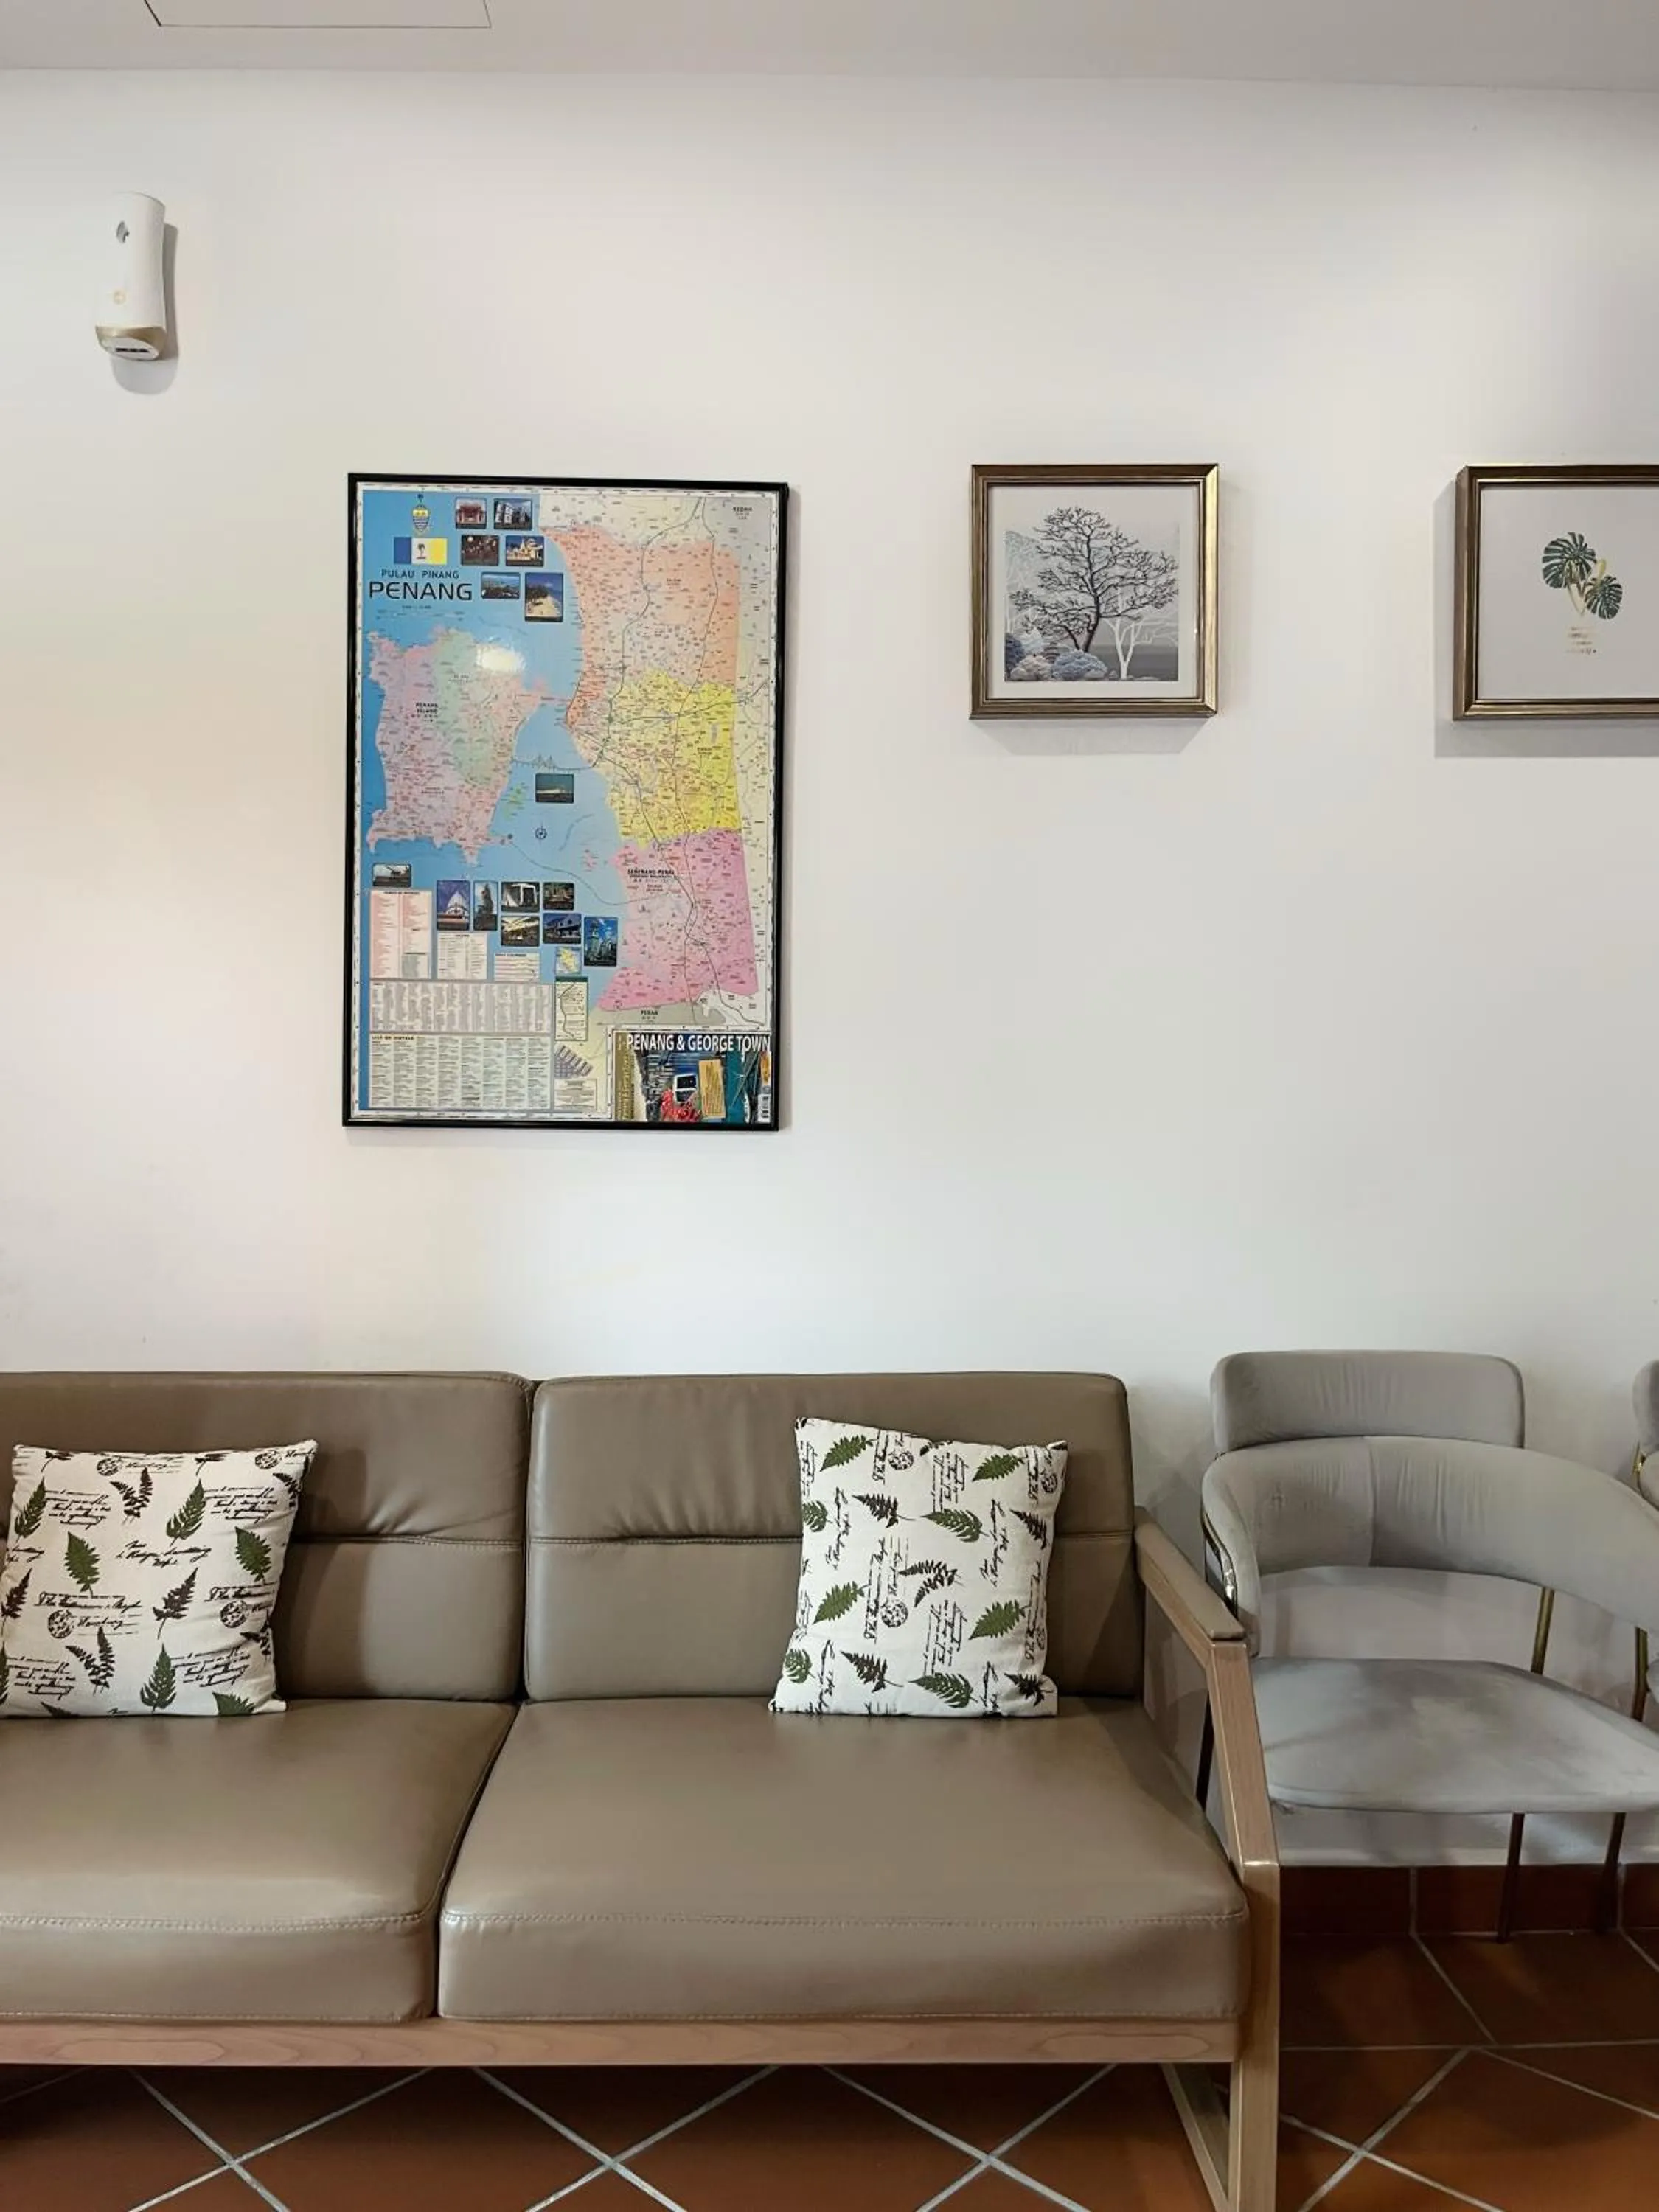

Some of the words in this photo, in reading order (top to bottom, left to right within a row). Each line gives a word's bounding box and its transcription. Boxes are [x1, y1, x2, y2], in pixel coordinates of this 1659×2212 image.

[381, 568, 415, 579] PULAU
[422, 570, 459, 579] PINANG
[369, 581, 473, 601] PENANG
[626, 1034, 675, 1051] PENANG
[677, 1034, 686, 1051] &
[688, 1034, 734, 1052] GEORGE
[736, 1034, 771, 1052] TOWN
